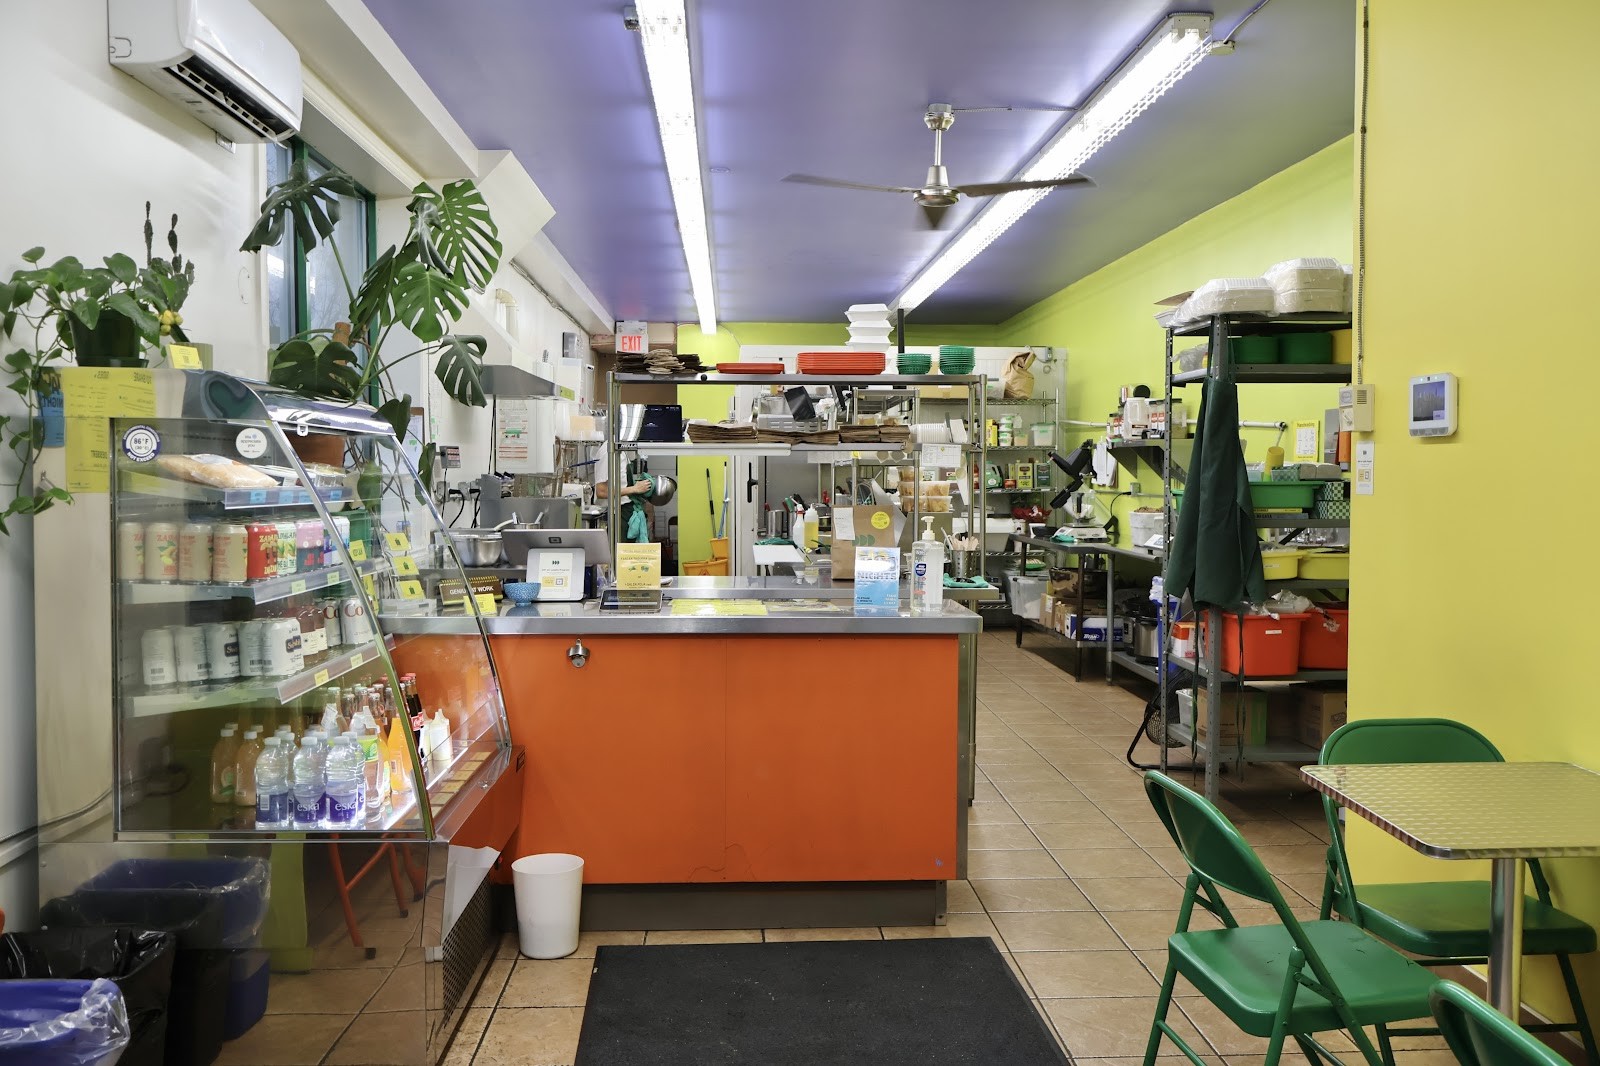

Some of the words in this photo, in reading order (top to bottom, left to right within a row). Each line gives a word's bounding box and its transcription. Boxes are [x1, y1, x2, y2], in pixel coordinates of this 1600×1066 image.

[621, 335, 642, 352] EXIT
[296, 802, 320, 812] eska
[334, 802, 358, 811] eska
